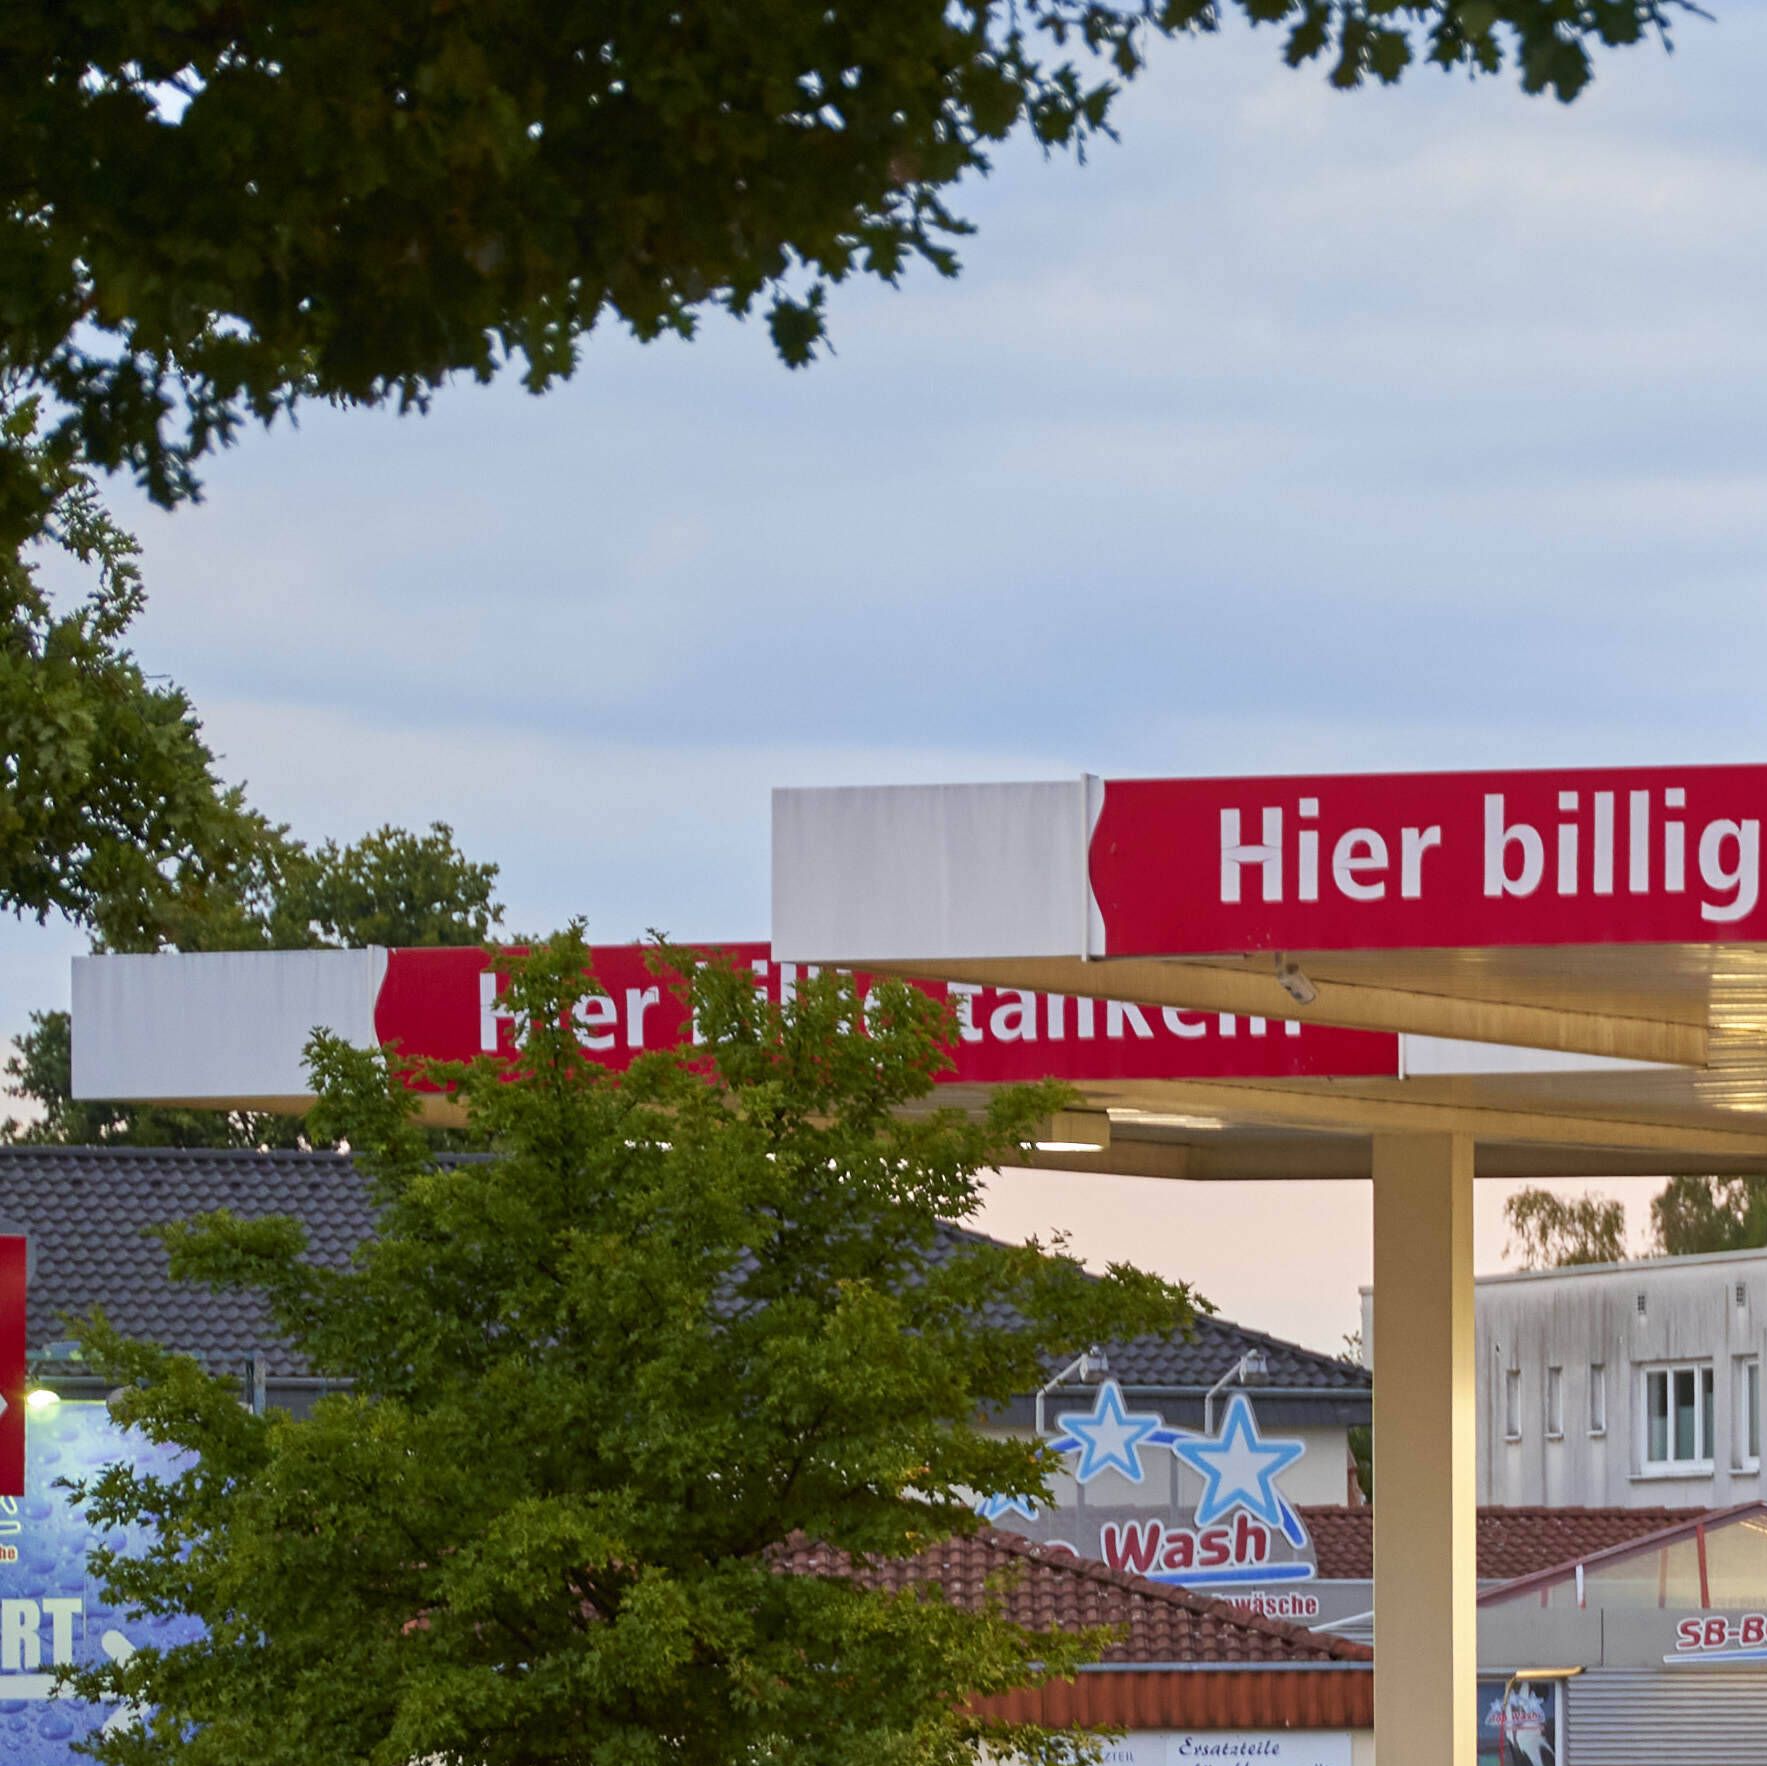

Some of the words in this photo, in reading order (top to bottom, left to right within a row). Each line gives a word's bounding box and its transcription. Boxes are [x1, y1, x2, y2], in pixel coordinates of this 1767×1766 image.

[1219, 796, 1441, 903] Hier
[1482, 787, 1760, 923] billig
[478, 971, 660, 1051] Her
[1102, 1511, 1268, 1575] Wash
[1178, 1736, 1280, 1757] Ersatzteile
